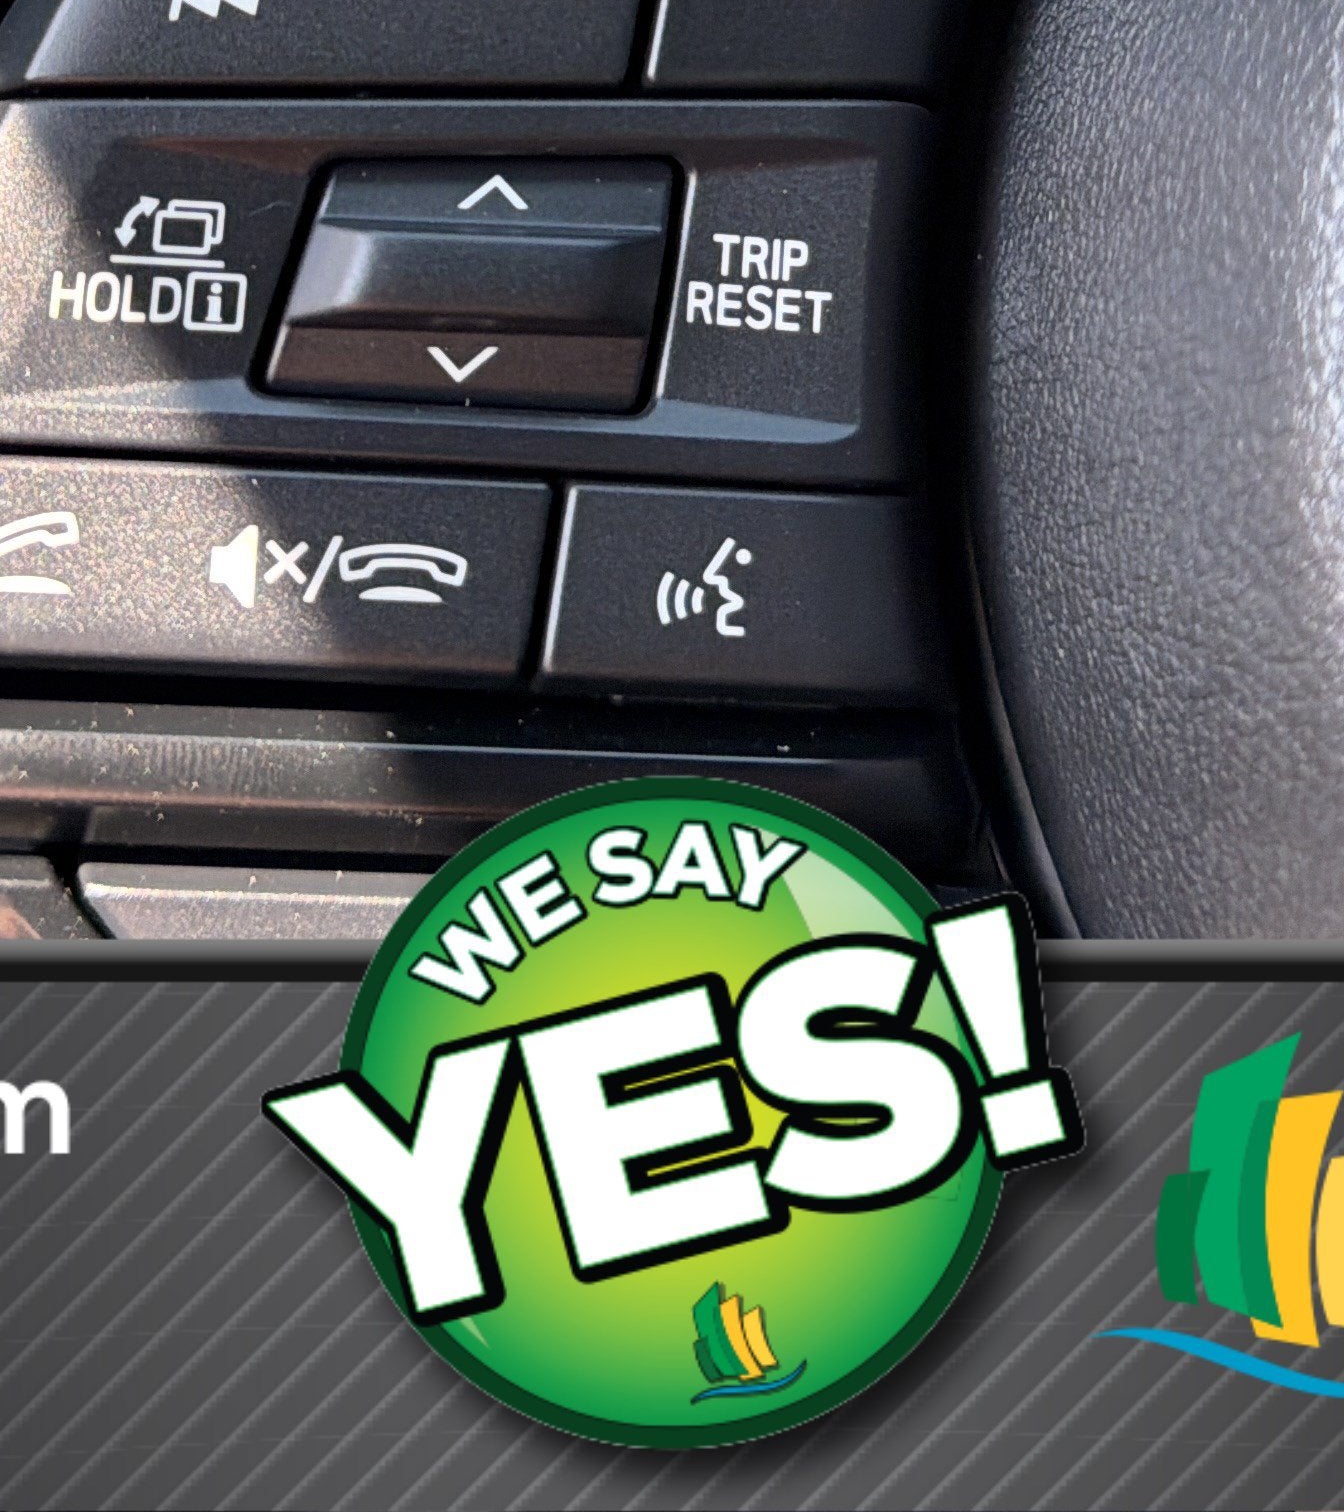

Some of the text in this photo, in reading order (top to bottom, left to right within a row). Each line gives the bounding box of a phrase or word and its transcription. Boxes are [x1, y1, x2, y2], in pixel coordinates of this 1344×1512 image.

[712, 233, 809, 279] TRIP
[48, 271, 182, 324] HOLD
[686, 281, 834, 334] RESET
